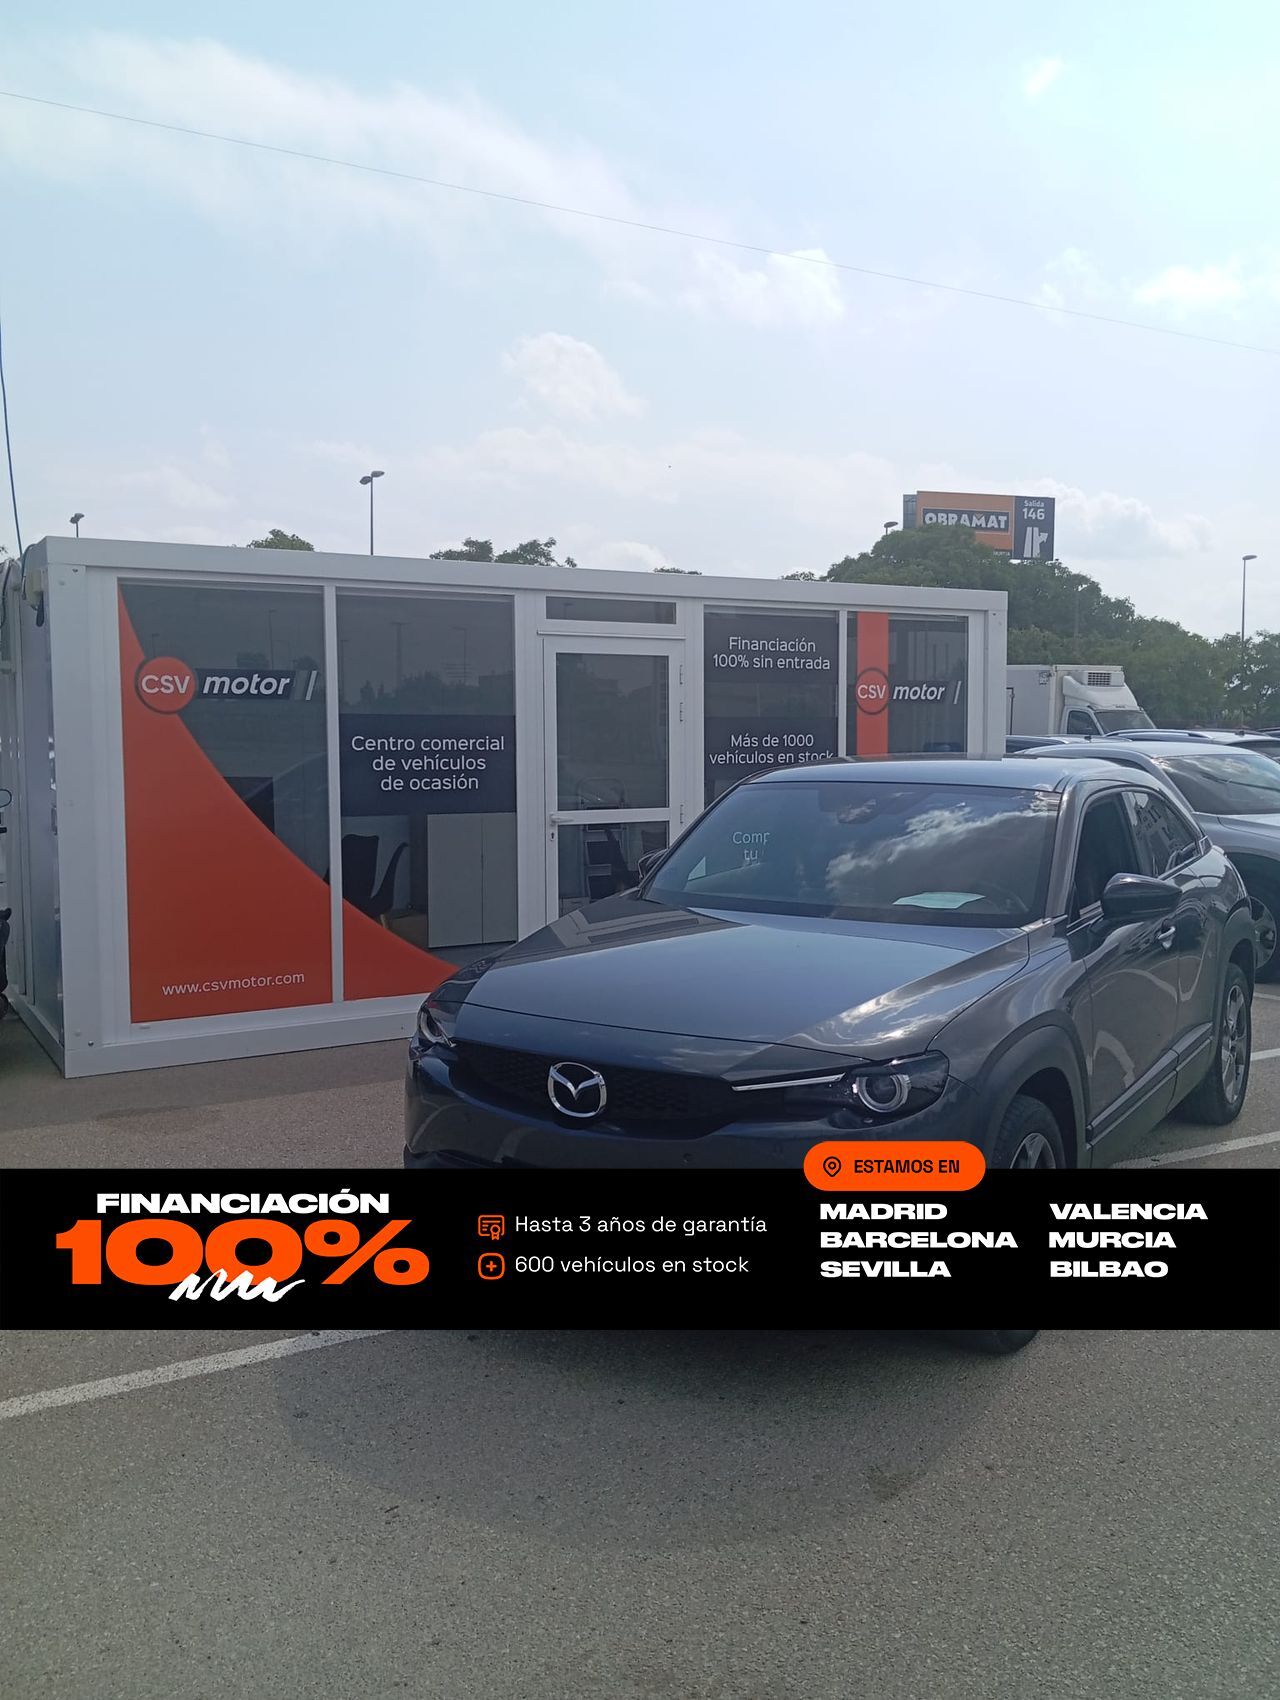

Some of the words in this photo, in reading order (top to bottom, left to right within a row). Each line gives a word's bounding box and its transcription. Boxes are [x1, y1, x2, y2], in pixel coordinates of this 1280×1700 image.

[1023, 500, 1045, 508] Salida
[924, 512, 1008, 529] OBRAMAT
[1022, 508, 1046, 520] 146
[729, 636, 816, 652] Financiación
[713, 654, 750, 668] 100%
[752, 655, 773, 668] sin
[777, 656, 831, 670] entrada
[141, 674, 191, 694] CSV
[203, 673, 291, 695] motor
[857, 684, 886, 699] CSV
[893, 683, 946, 700] motor
[351, 735, 415, 751] Centro
[420, 735, 505, 751] comercial
[730, 733, 759, 747] Más
[762, 734, 779, 747] de
[783, 734, 814, 747] 1000
[372, 756, 396, 771] de
[401, 754, 487, 771] vehículos
[709, 749, 774, 765] vehículos
[777, 753, 794, 764] en
[380, 776, 404, 791] de
[409, 773, 479, 791] ocasión
[162, 973, 305, 996] www.csvmotor.com
